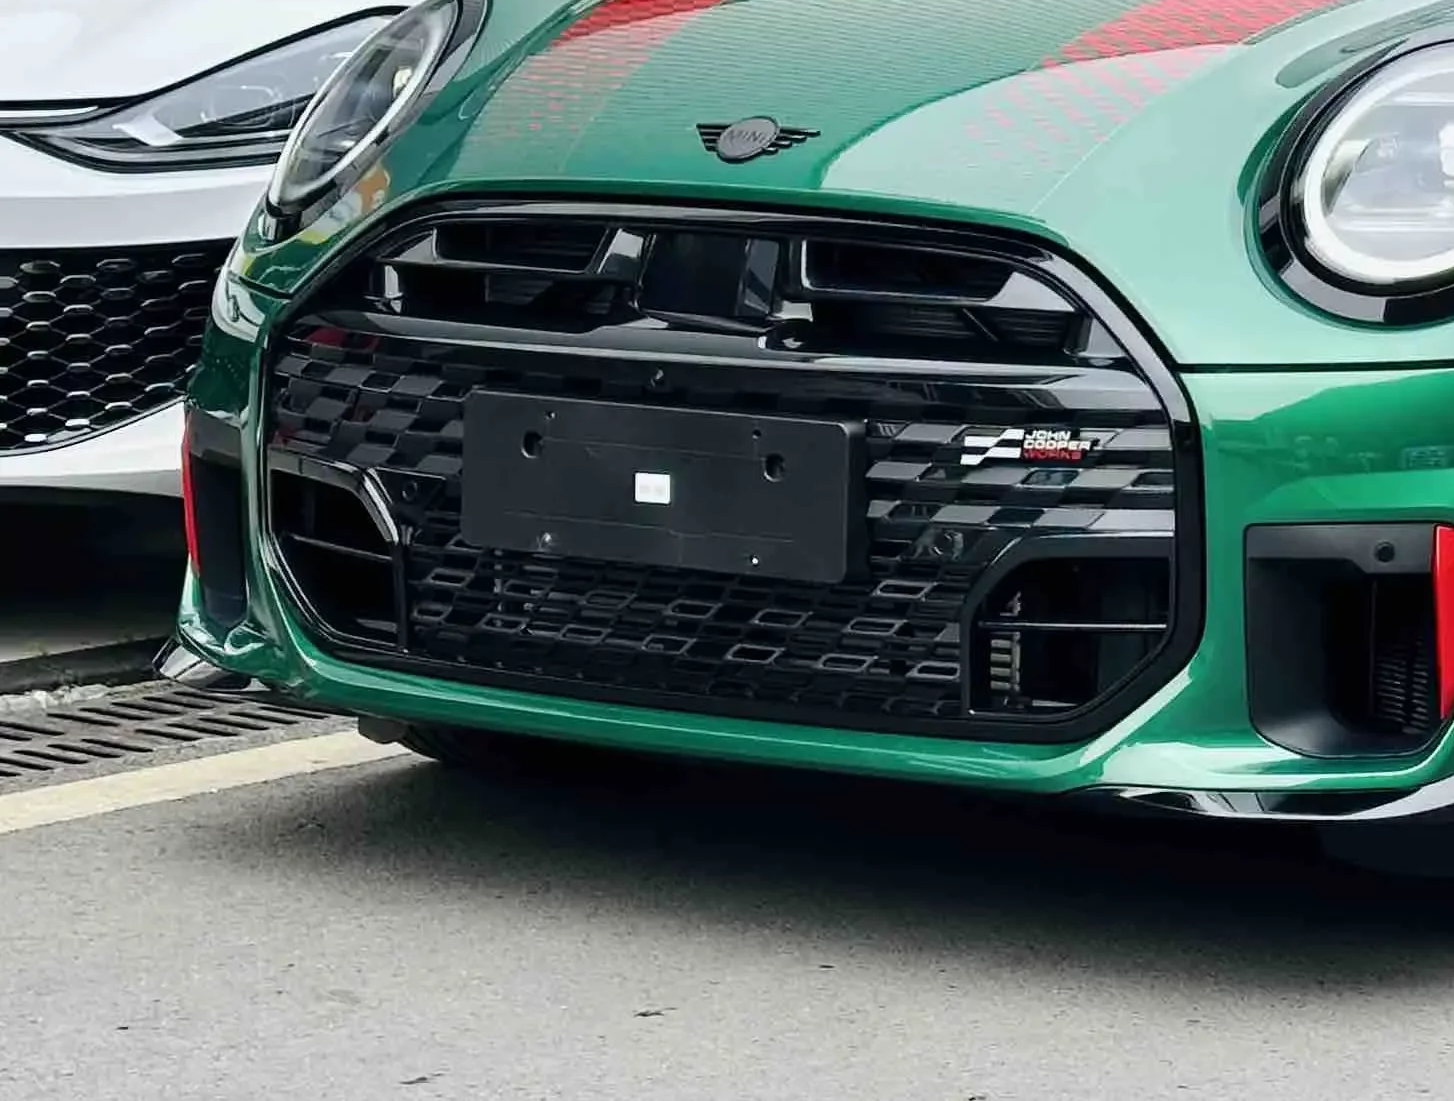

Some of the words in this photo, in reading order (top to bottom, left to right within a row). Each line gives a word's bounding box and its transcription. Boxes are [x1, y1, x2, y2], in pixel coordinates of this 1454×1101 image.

[1024, 429, 1072, 440] JOHN
[1023, 439, 1092, 451] COOPER
[1023, 450, 1083, 461] WORKS
